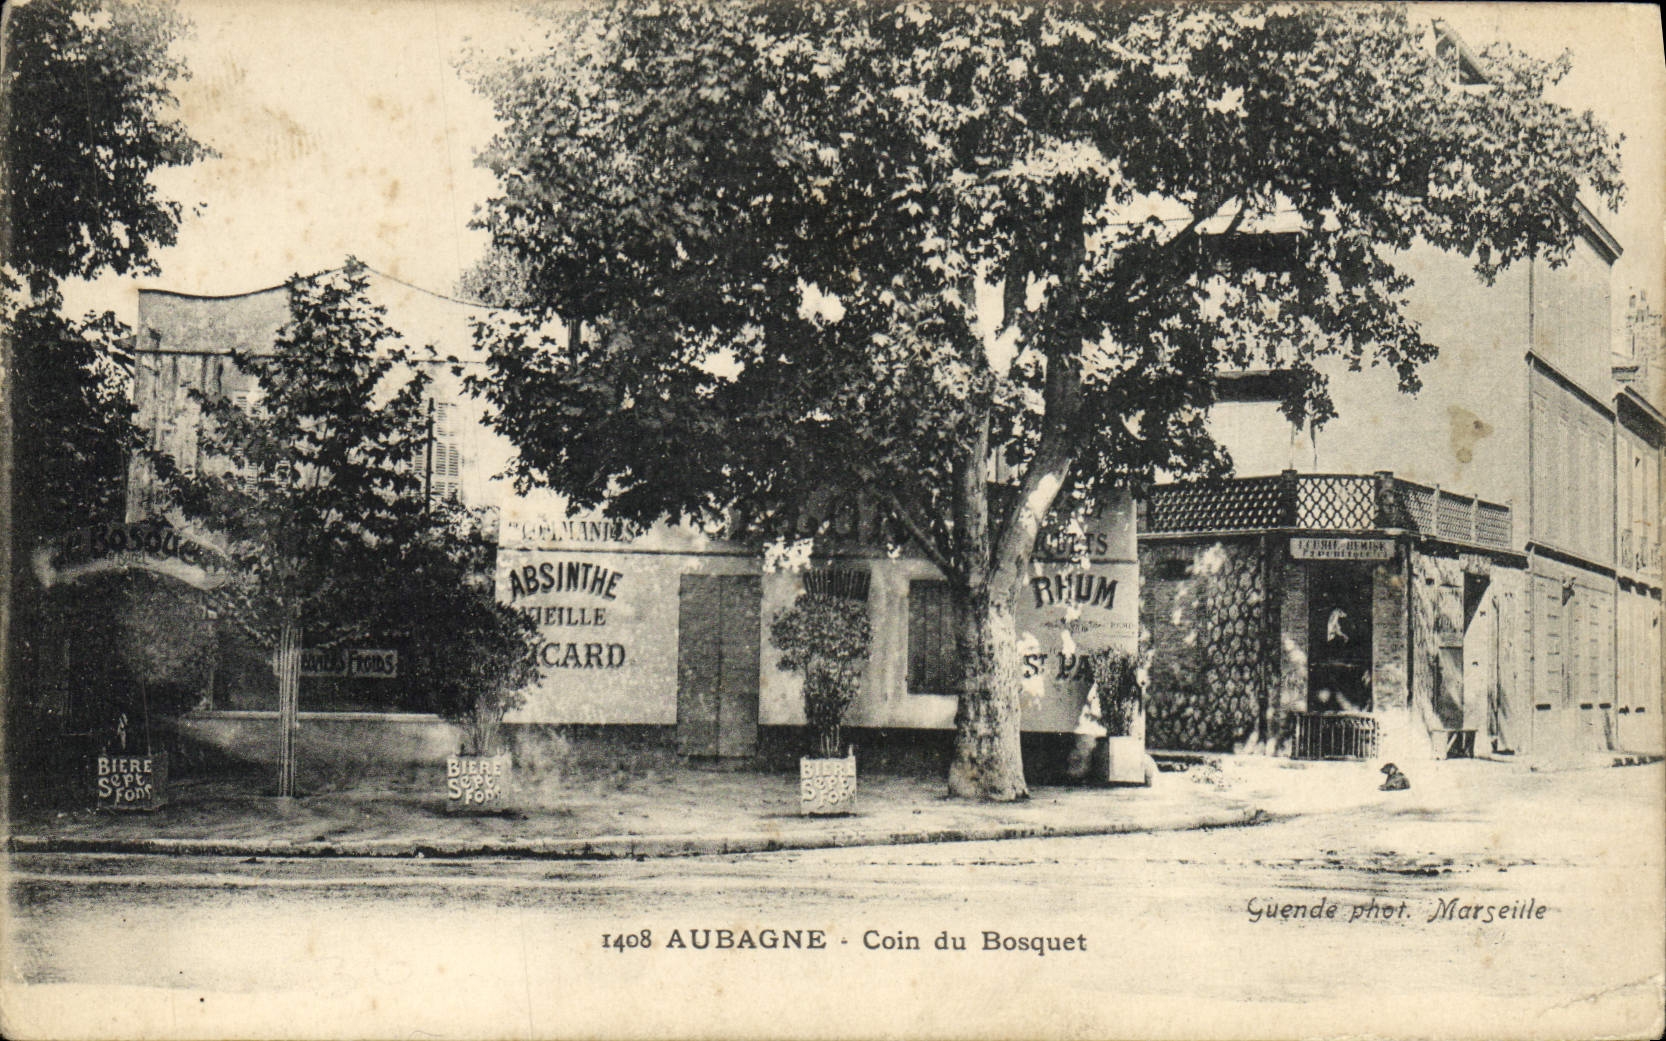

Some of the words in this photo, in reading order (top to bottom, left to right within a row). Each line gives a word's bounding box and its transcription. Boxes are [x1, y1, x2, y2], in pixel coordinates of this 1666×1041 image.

[509, 561, 624, 601] ABSINTHE
[1030, 572, 1119, 610] RHUM
[98, 757, 152, 776] BIERE
[447, 758, 501, 777] BIERE
[801, 760, 855, 780] BIERE
